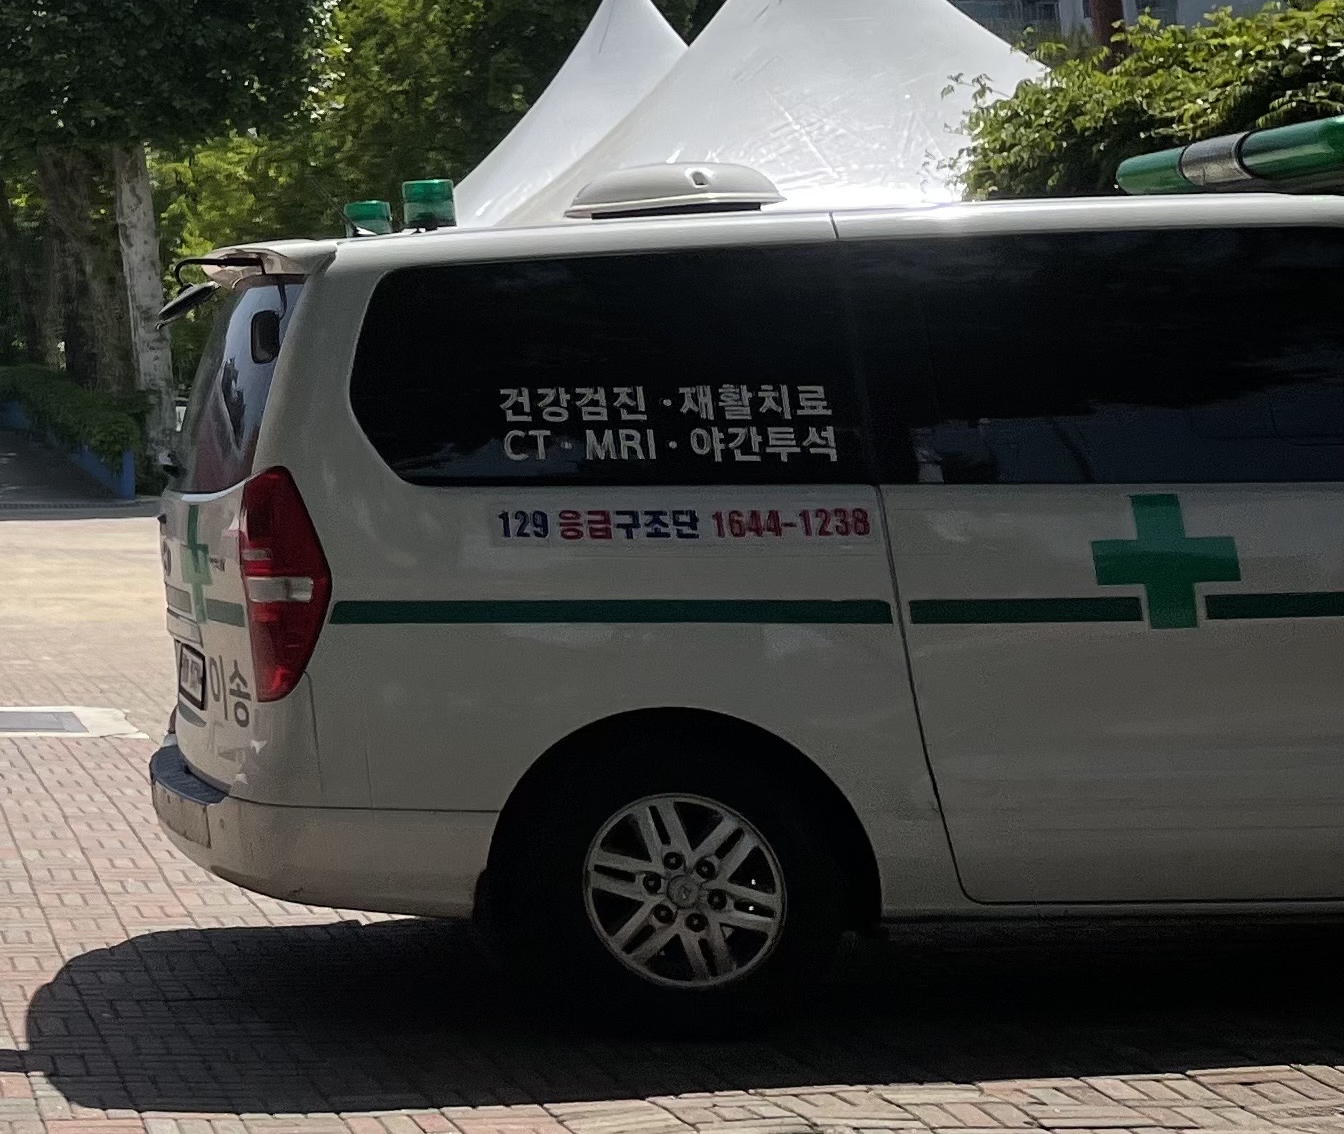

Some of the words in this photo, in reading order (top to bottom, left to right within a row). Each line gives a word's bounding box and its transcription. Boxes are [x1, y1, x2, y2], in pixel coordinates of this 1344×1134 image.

[498, 385, 648, 423] 건강검진
[678, 383, 833, 420] 재활치료
[503, 429, 552, 461] CT
[585, 428, 657, 461] MRI
[690, 426, 838, 463] 야간투석
[498, 509, 549, 539] 129
[558, 509, 700, 540] 응급구조단
[712, 507, 871, 539] 1644-1238
